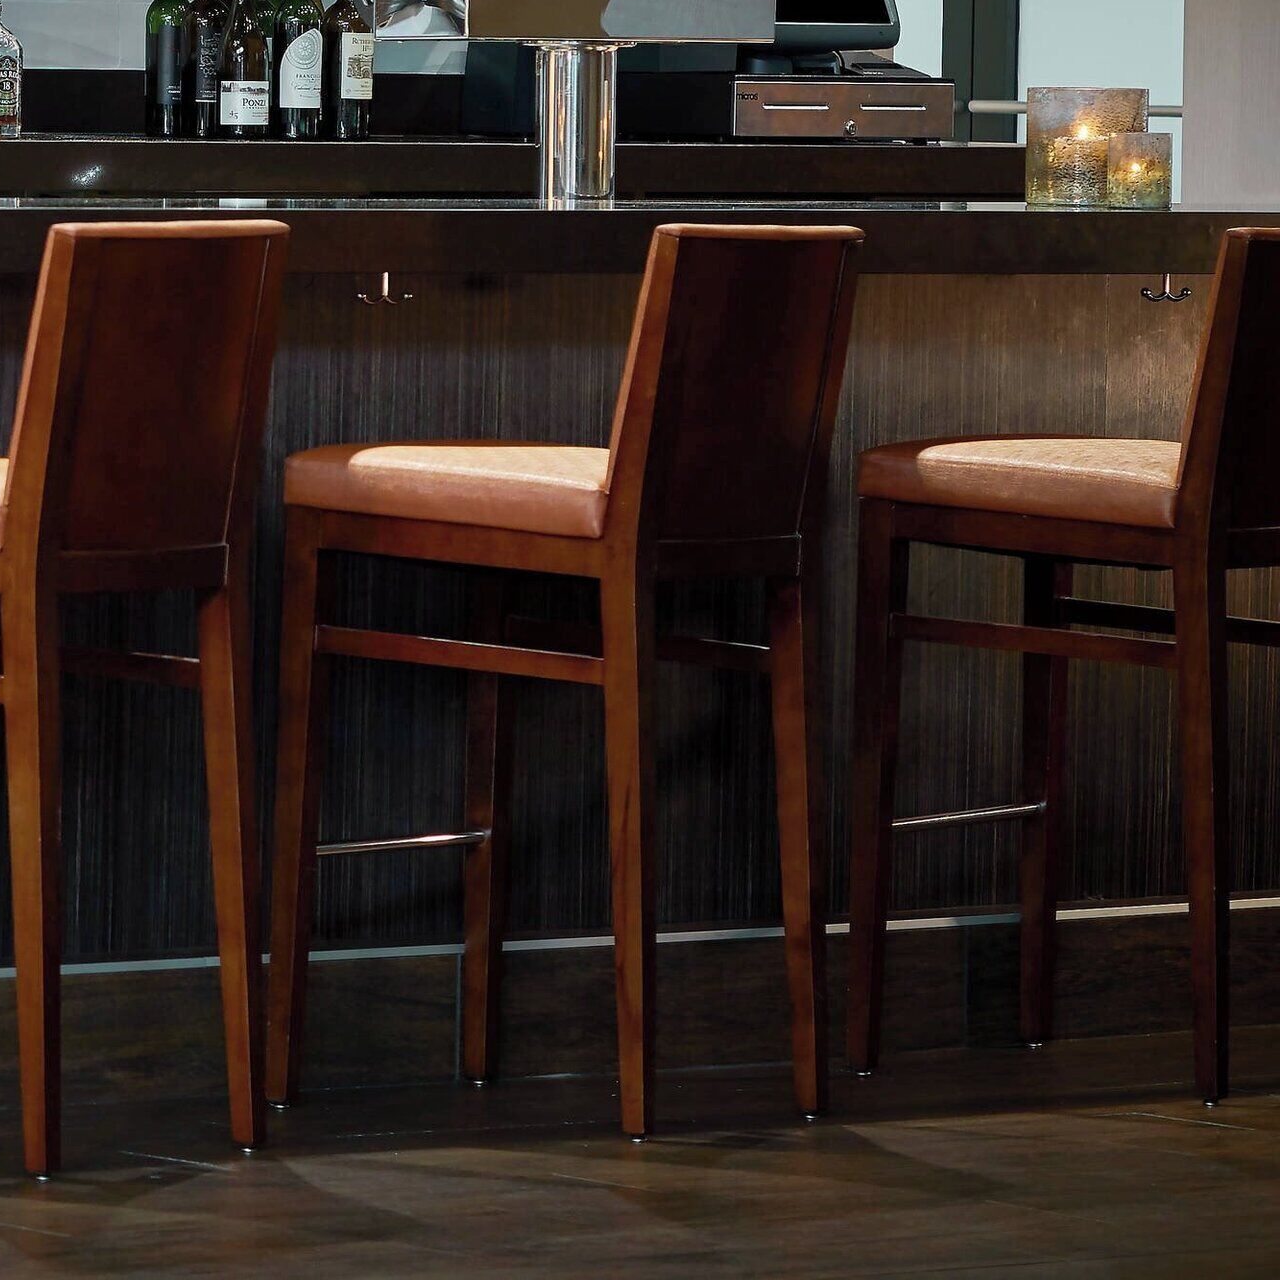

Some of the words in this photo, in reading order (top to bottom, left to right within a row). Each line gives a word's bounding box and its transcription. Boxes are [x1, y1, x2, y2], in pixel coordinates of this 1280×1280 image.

[3, 82, 11, 90] 18
[736, 92, 759, 100] micros
[242, 97, 267, 106] PONZI
